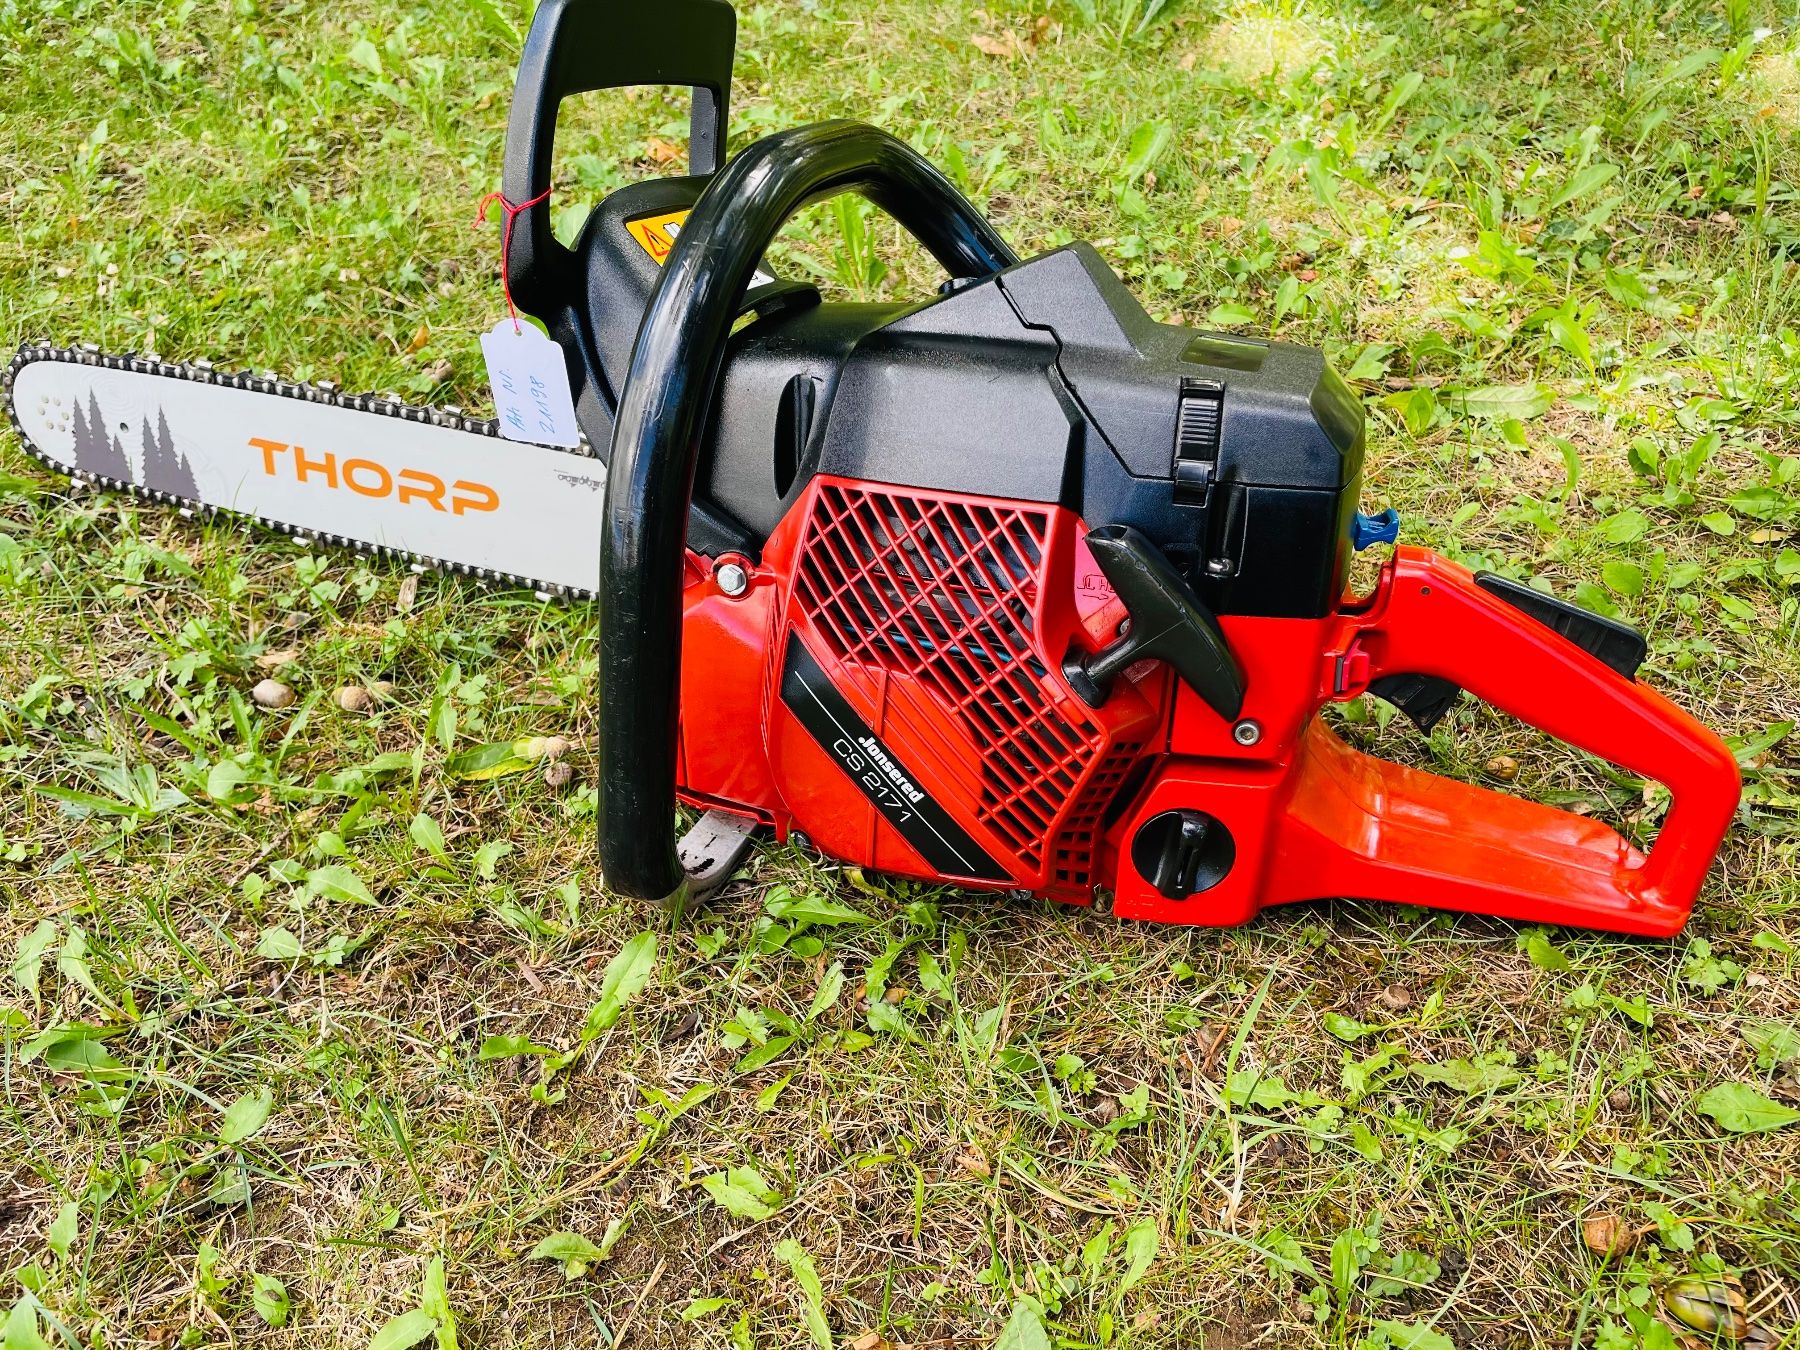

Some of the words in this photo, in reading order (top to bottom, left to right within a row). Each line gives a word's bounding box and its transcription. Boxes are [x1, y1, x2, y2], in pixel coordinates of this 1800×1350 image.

[248, 437, 500, 516] THORP
[833, 738, 865, 772] CS
[862, 772, 912, 823] 2171
[858, 736, 925, 804] Jonsered
